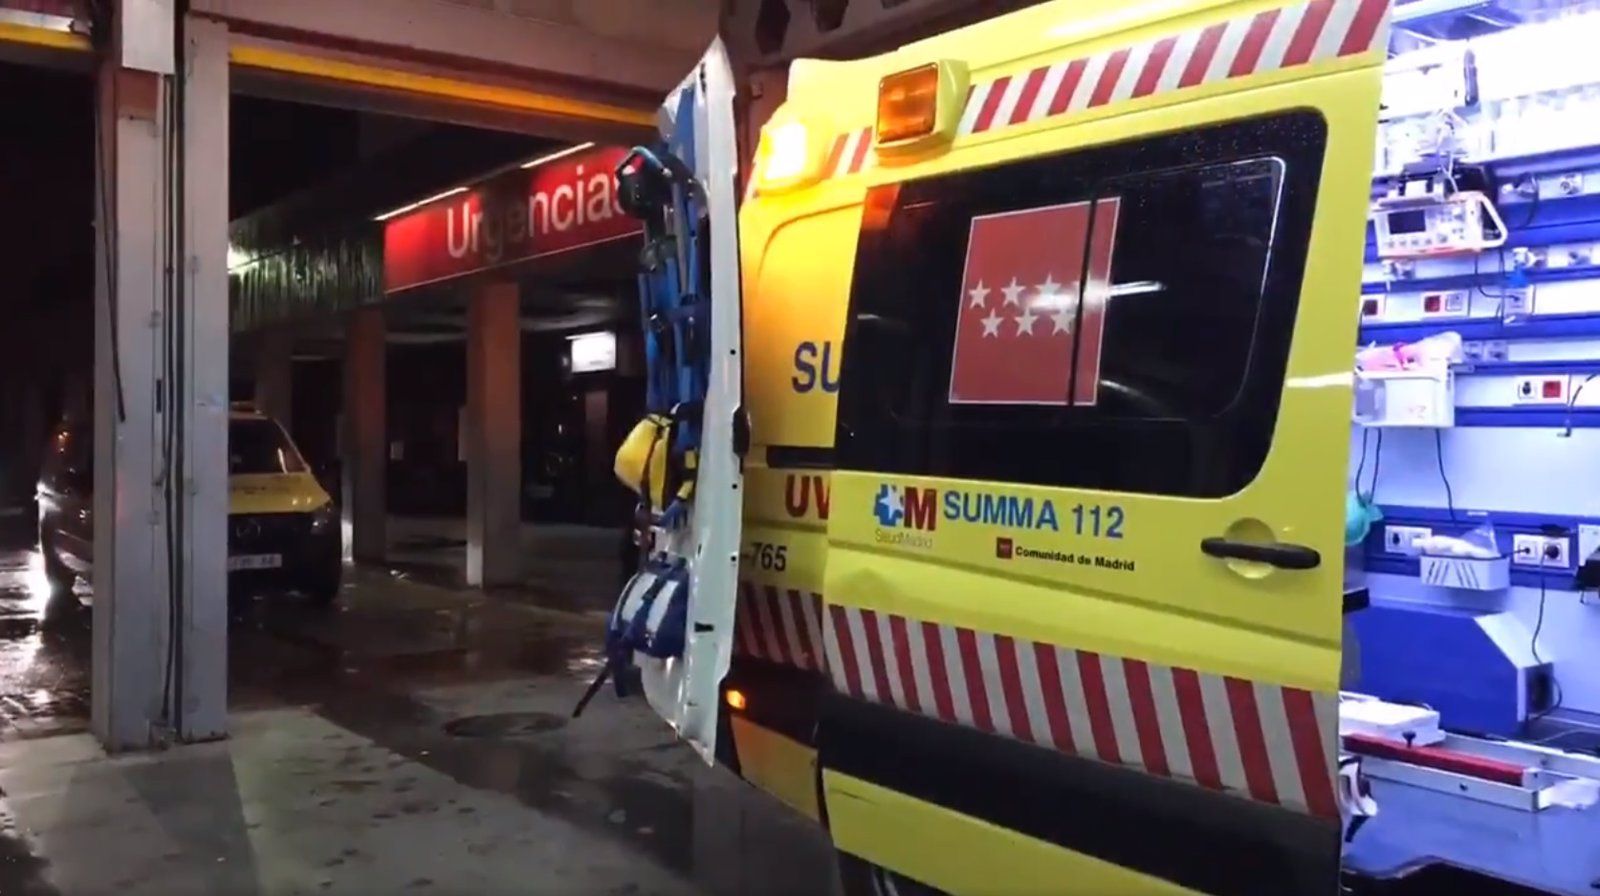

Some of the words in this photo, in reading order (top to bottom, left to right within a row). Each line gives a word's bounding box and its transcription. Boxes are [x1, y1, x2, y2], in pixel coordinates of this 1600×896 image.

[944, 491, 1058, 531] SUMMA
[1072, 504, 1124, 538] 112
[1015, 546, 1074, 564] Comunidad
[1077, 552, 1091, 566] de
[1095, 556, 1135, 571] Madrid
